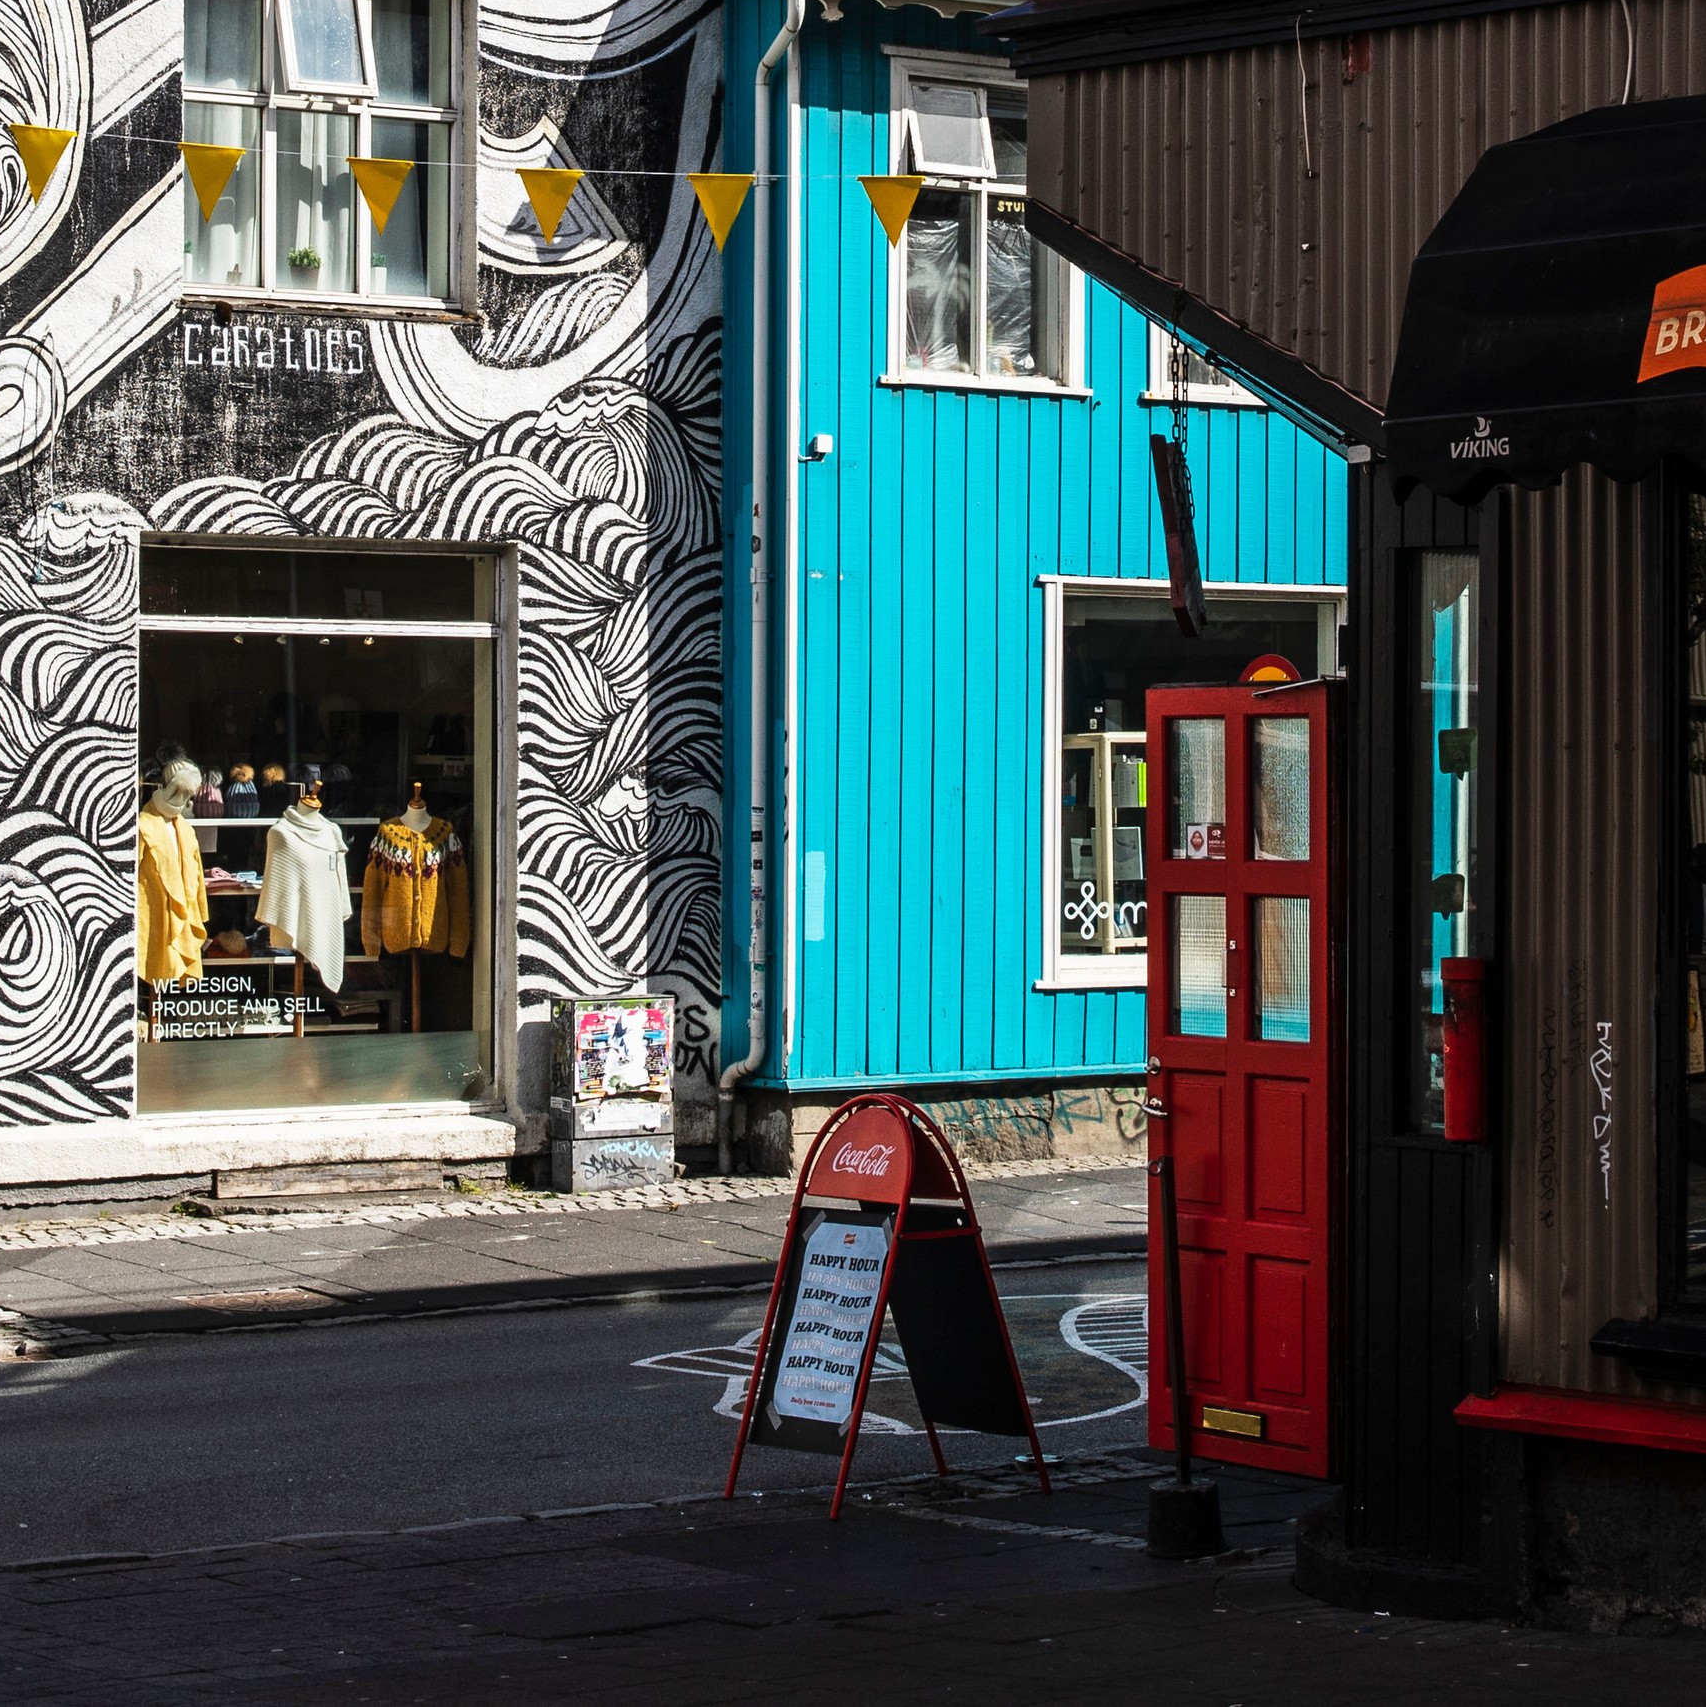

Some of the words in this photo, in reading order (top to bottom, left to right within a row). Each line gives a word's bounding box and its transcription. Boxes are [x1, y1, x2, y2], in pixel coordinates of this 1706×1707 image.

[997, 200, 1026, 213] STU
[1450, 436, 1510, 459] VÍKING
[152, 977, 181, 994] WE
[186, 975, 256, 995] DESIGN,
[152, 999, 239, 1017] PRODUCE
[242, 998, 280, 1015] AND
[284, 997, 326, 1014] SELL
[152, 1020, 248, 1039] DIRECTLY
[810, 1253, 847, 1271] HAPPY
[849, 1255, 881, 1272] HOUR
[806, 1271, 843, 1288] HAPPY
[845, 1274, 877, 1290] HOUR
[802, 1288, 840, 1304] HAPPY
[840, 1293, 873, 1309] HOUR
[799, 1305, 836, 1322] HAPPY
[837, 1311, 869, 1326] HOUR
[794, 1321, 832, 1338] HAPPY
[832, 1328, 864, 1343] HOUR
[791, 1339, 827, 1355] HAPPY
[828, 1345, 861, 1360] HOUR
[786, 1355, 822, 1372] HAPPY
[823, 1361, 856, 1377] HOUR
[782, 1374, 818, 1391] HAPPY
[820, 1379, 852, 1395] HOUR
